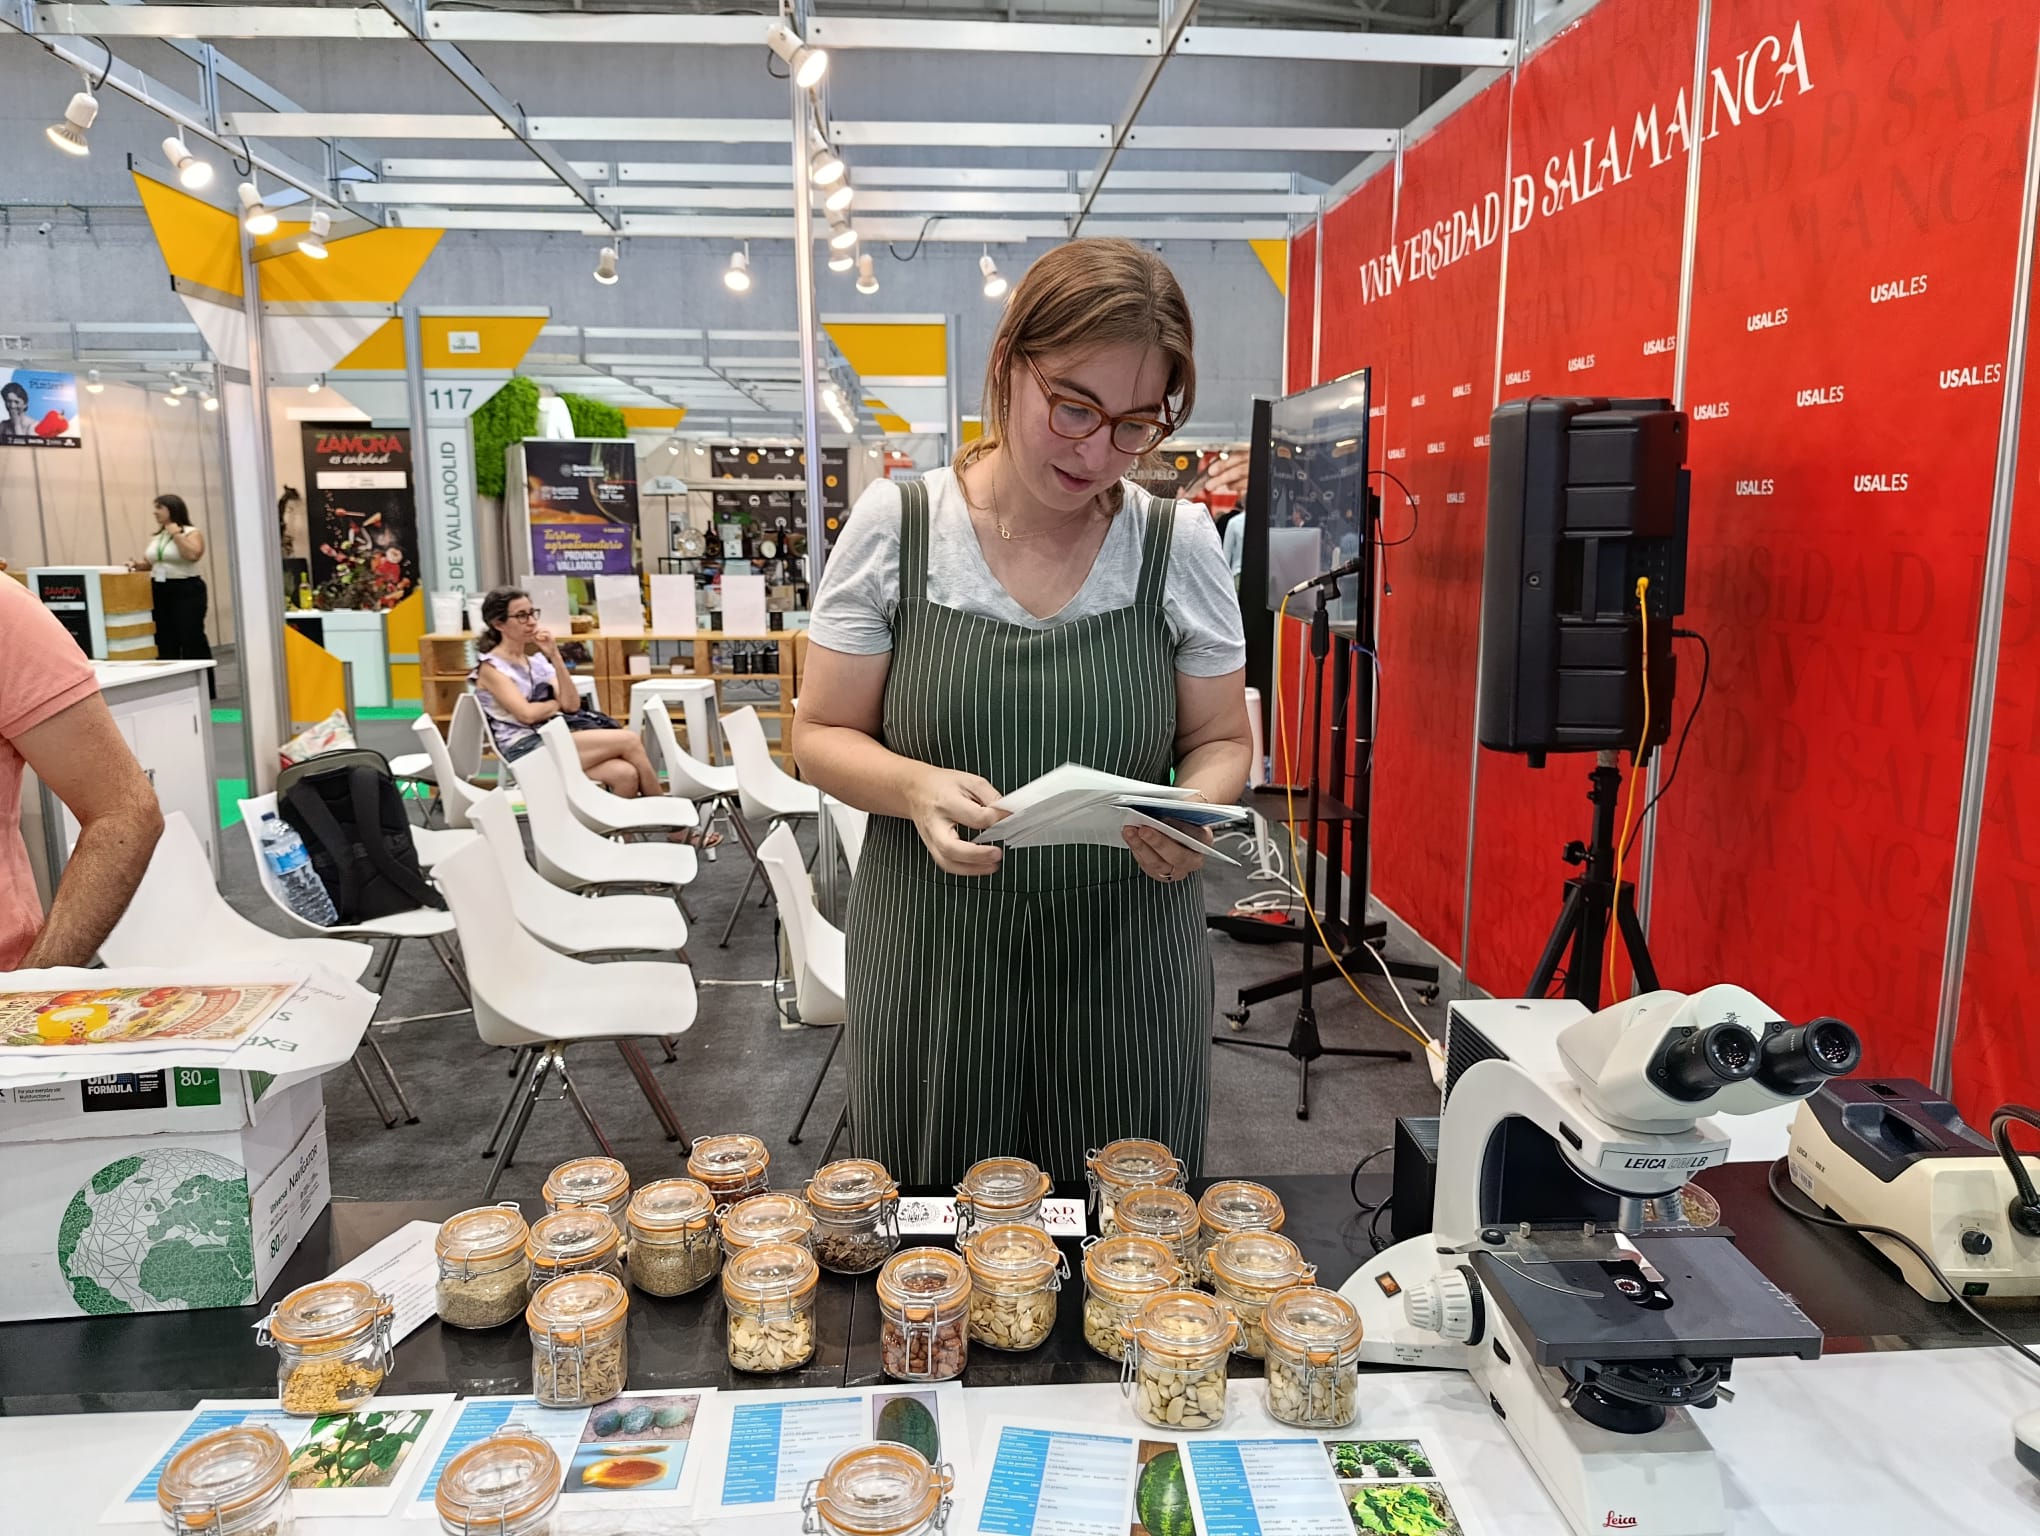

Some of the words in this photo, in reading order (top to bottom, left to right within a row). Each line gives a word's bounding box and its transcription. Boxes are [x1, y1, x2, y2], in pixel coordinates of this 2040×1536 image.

[1542, 19, 1815, 218] SALAMANCA
[1870, 275, 1928, 304] USAL.ES
[1747, 308, 1788, 332] USAL.ES
[1643, 336, 1676, 356] USAL.ES
[1568, 354, 1595, 372] USAL.ES
[1939, 363, 2003, 389] USAL.ES
[430, 388, 473, 410] 117
[1797, 385, 1845, 407] USAL.ES
[1693, 402, 1729, 421] USAL.ES
[316, 435, 403, 453] ZAMORA
[1736, 479, 1774, 496] USAL.ES
[1854, 473, 1909, 493] USAL.ES
[440, 440, 463, 551] VALLADOLID
[562, 550, 605, 561] PROVINCIA
[450, 555, 464, 580] DE
[556, 561, 604, 571] VALLADOLID
[180, 1070, 202, 1086] 80
[88, 1084, 133, 1095] FORMULA
[1624, 1158, 1667, 1169] LEICA
[270, 1233, 280, 1258] 80
[1602, 1510, 1640, 1528] Leica
